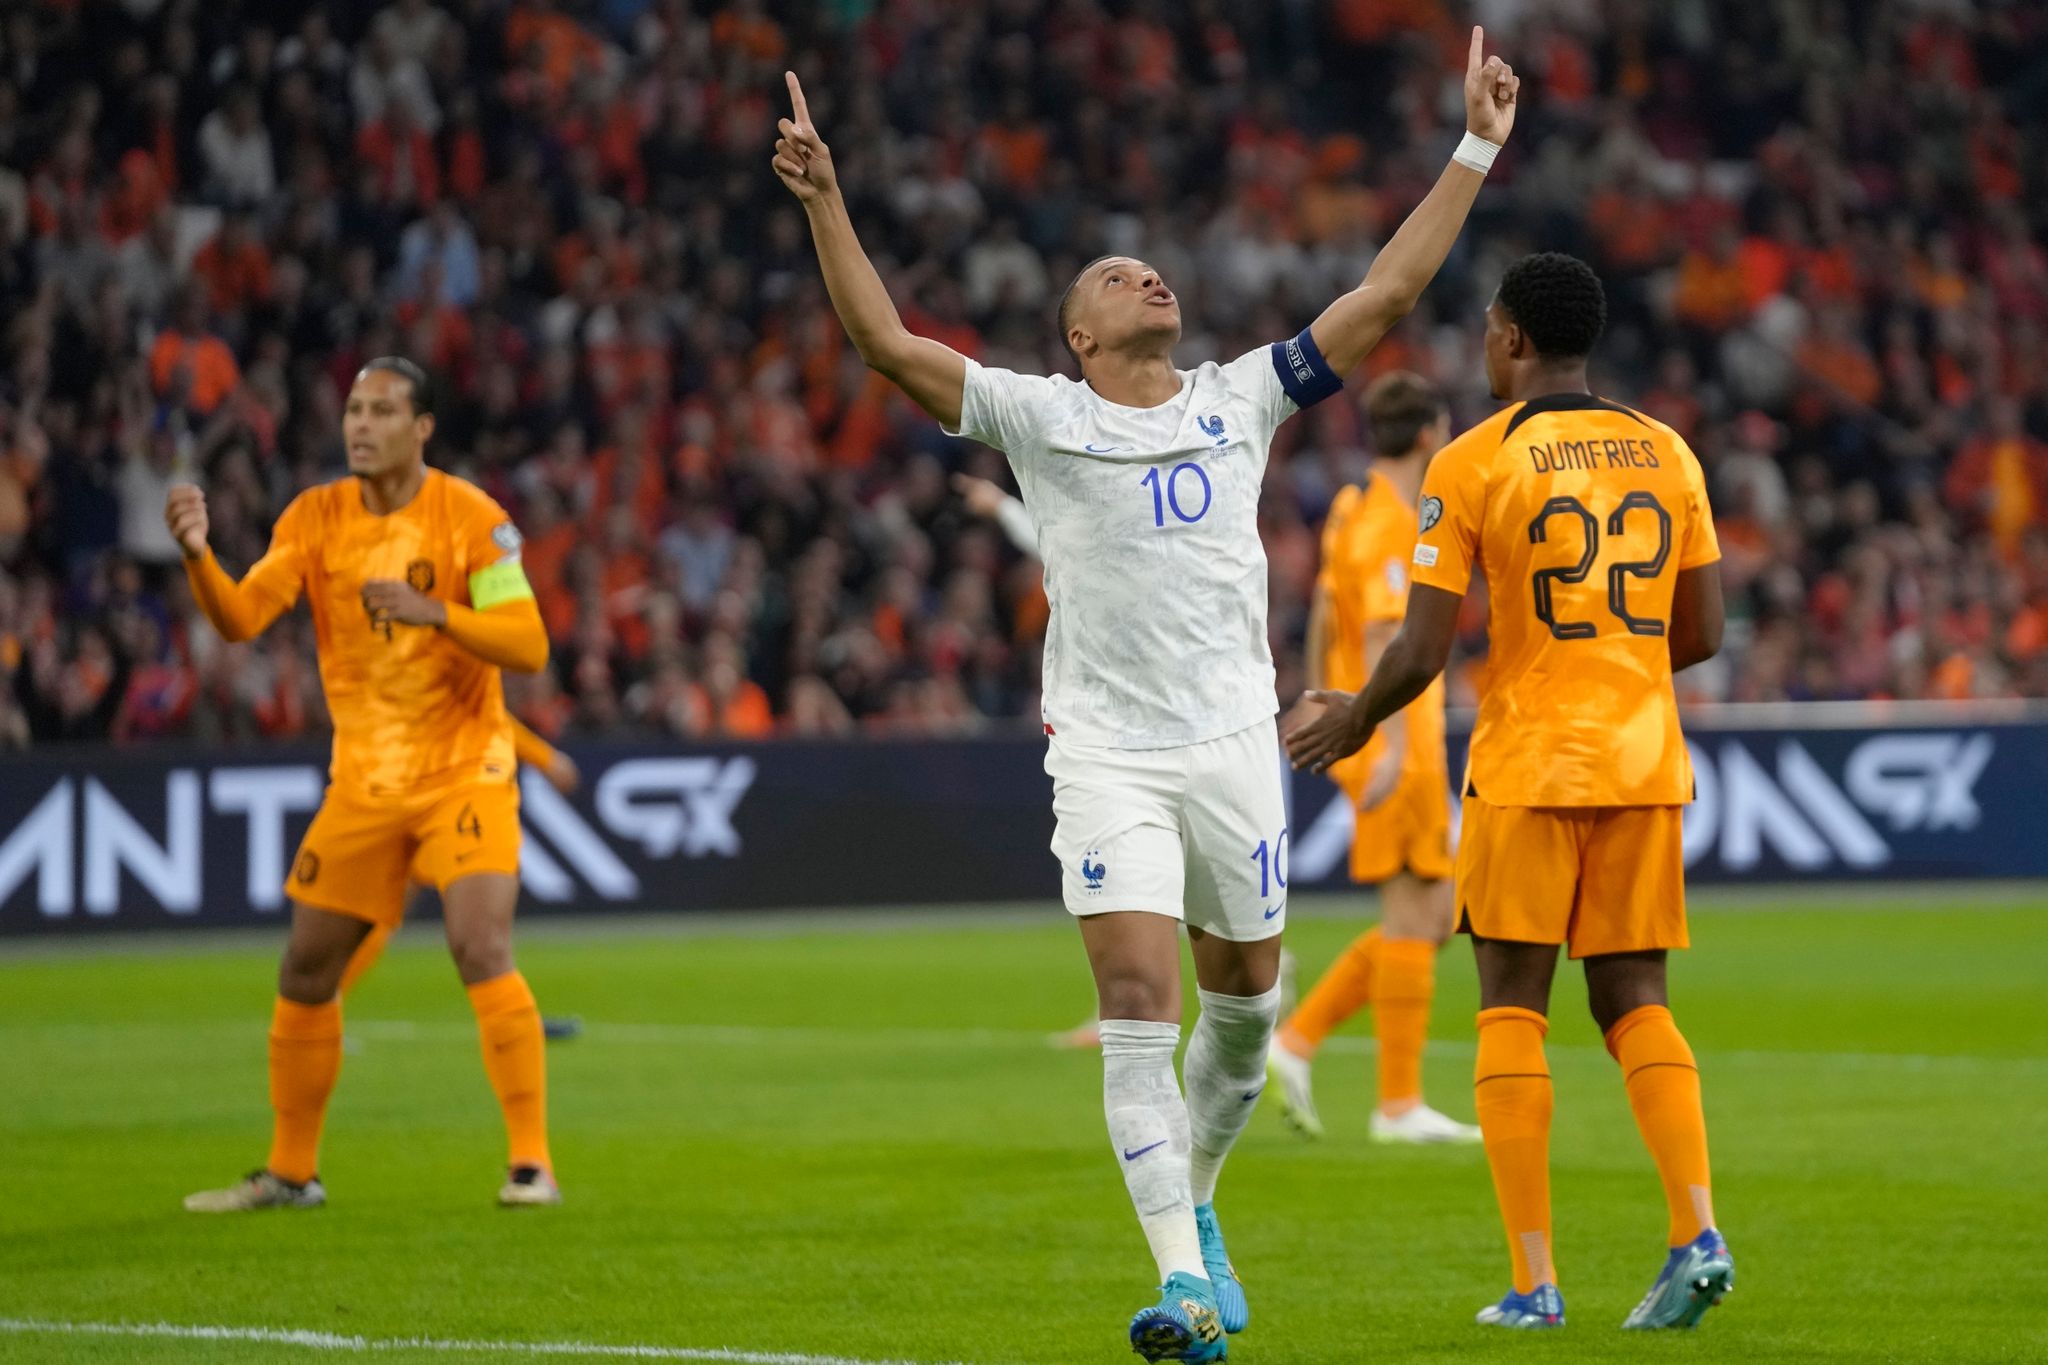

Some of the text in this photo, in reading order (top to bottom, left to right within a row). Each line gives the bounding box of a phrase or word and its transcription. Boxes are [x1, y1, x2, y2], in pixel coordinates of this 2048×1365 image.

[1529, 440, 1660, 473] DUMFRIES
[1140, 462, 1211, 527] 10
[1528, 491, 1672, 641] 22
[456, 801, 481, 840] 4
